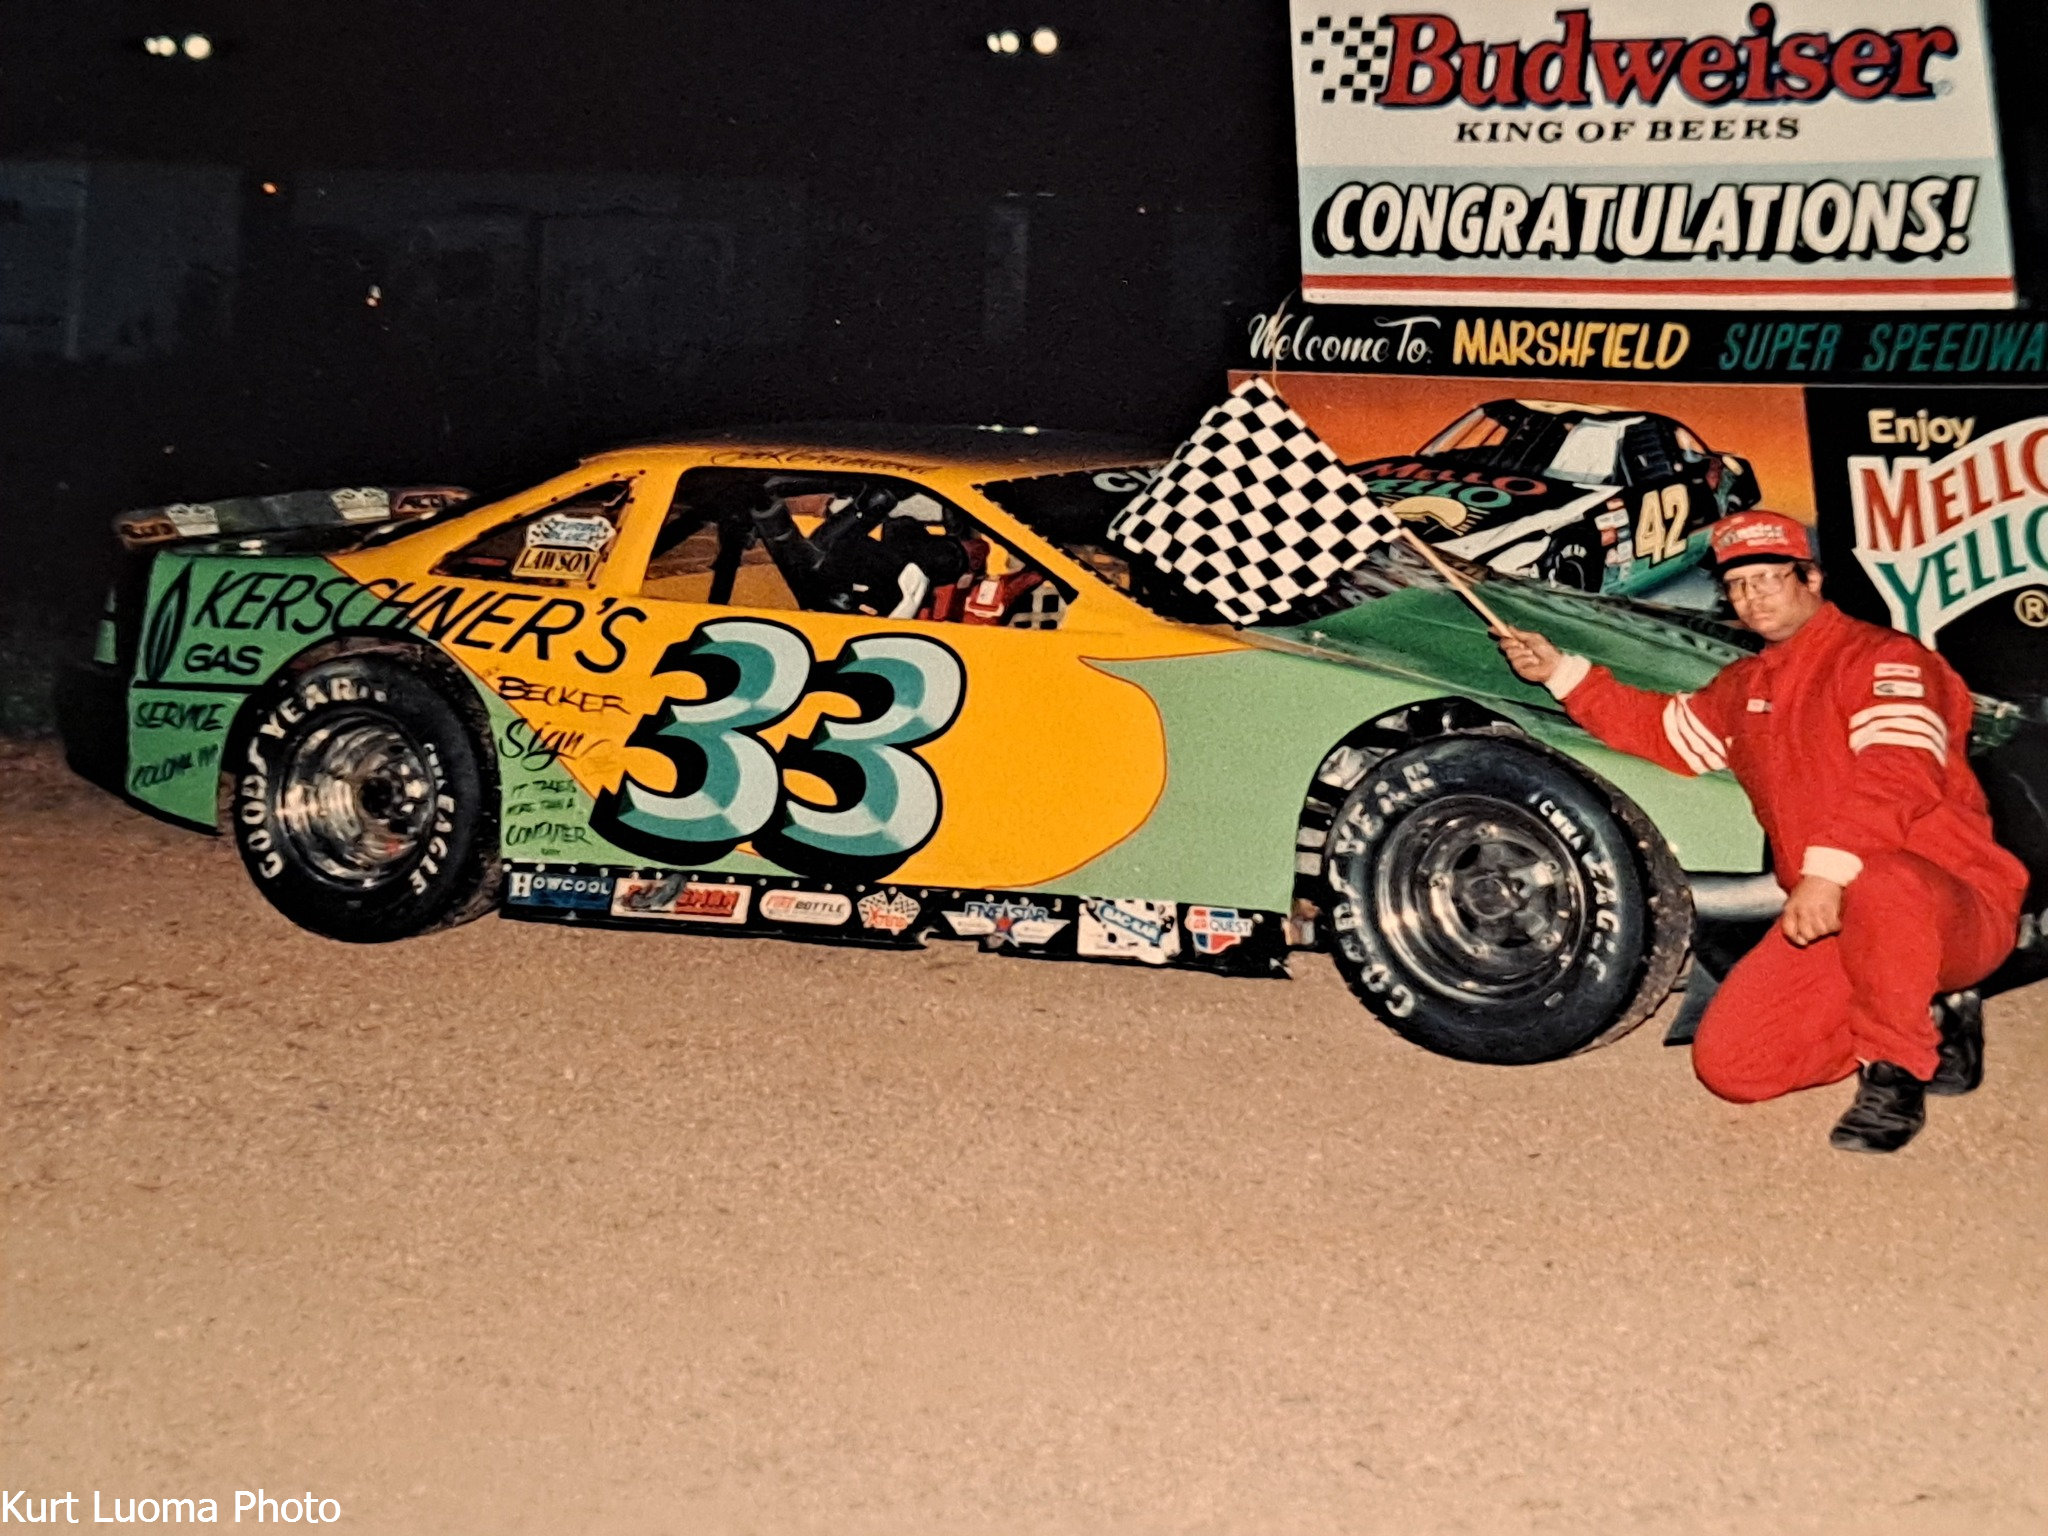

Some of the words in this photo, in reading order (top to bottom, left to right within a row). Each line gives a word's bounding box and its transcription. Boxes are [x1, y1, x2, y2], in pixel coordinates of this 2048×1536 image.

[1378, 2, 1957, 108] Budweiser
[1456, 120, 1563, 145] KING
[1577, 119, 1632, 143] OF
[1649, 117, 1801, 142] BEERS
[1314, 175, 1979, 263] CONGRATULATIONS!
[1248, 313, 1390, 363] Welcome
[1453, 318, 1691, 369] MARSHFIELD
[1718, 322, 1842, 371] SUPER
[1868, 408, 1976, 451] Enjoy
[1368, 479, 1511, 508] ELLO
[1635, 483, 1688, 566] 42
[519, 549, 592, 572] LAWSON
[190, 568, 647, 674] KERSCHNER'S
[184, 644, 264, 673] GAS
[497, 675, 631, 714] BECKER
[588, 616, 967, 883] 33
